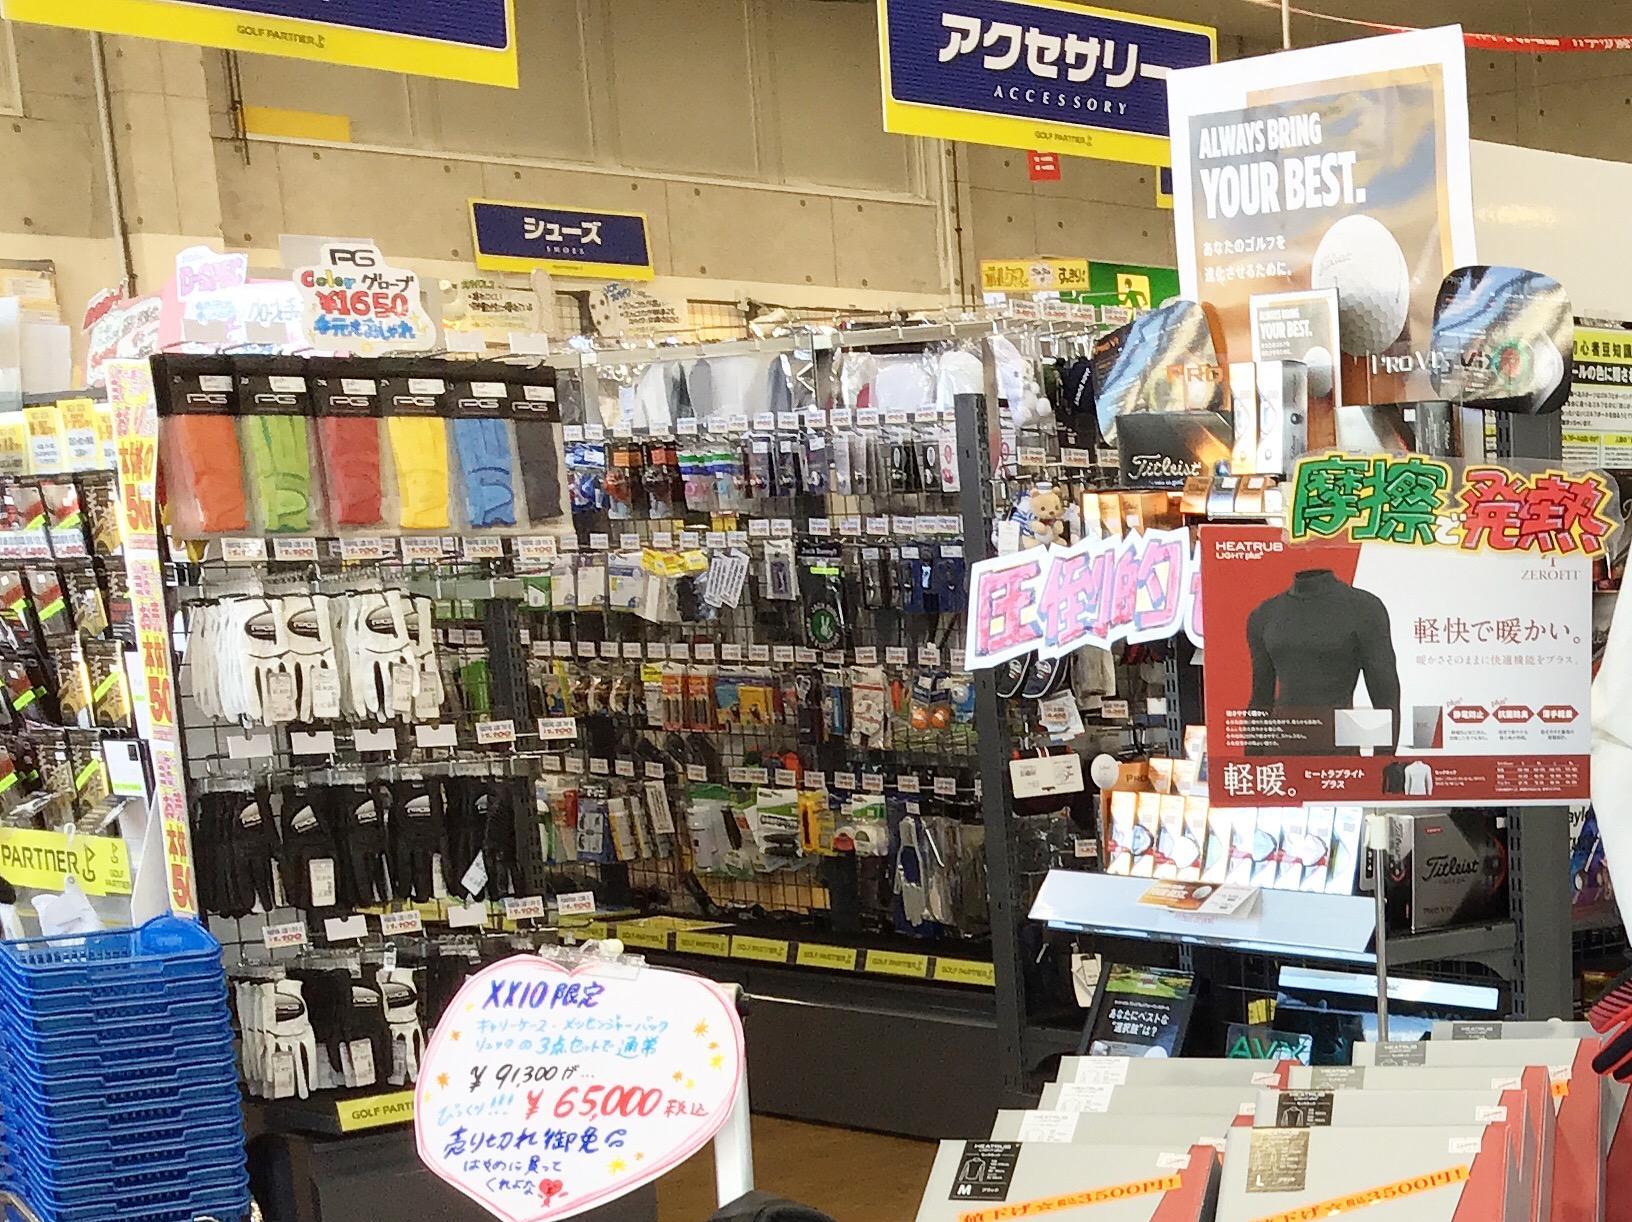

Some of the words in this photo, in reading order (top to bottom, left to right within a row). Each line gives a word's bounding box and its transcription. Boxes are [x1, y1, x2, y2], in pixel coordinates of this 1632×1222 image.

[939, 13, 1168, 88] アクセサリー
[993, 85, 1129, 117] ACCESSORY
[1199, 117, 1270, 160] ALWAYS
[1271, 110, 1323, 152] BRING
[1199, 162, 1282, 219] YOUR
[1284, 150, 1367, 210] BEST.
[523, 216, 602, 246] シューズ
[329, 248, 376, 268] PG
[1203, 234, 1287, 258] あなたのゴルフを
[301, 269, 356, 289] Color
[361, 271, 415, 292] グローブ
[316, 290, 409, 317] ¥1650
[1260, 322, 1286, 340] YOUR
[1287, 320, 1313, 338] BEST.
[1128, 454, 1202, 480] Titleist
[1291, 454, 1614, 554] 摩擦で発熱
[1215, 540, 1284, 552] HEATRUB
[1215, 552, 1245, 561] LIGHT
[1520, 569, 1583, 582] ZEROFIT
[975, 540, 1204, 657] 圧倒的
[1413, 616, 1583, 646] 軽快で暖かい。
[1223, 762, 1298, 798] 軽暖。
[1304, 769, 1366, 779] ヒートラブライト
[1321, 779, 1345, 790] プラス
[2, 844, 80, 876] PARTNER
[1422, 854, 1479, 882] Titleist
[550, 981, 606, 1010] 限定
[1108, 1009, 1170, 1027] あなたにベストな
[495, 1064, 558, 1089] 91,300
[351, 1105, 386, 1121] GOLF
[388, 1100, 415, 1116] PART
[553, 1085, 663, 1122] 65,000
[957, 1184, 972, 1196] M
[1255, 1174, 1265, 1187] L
